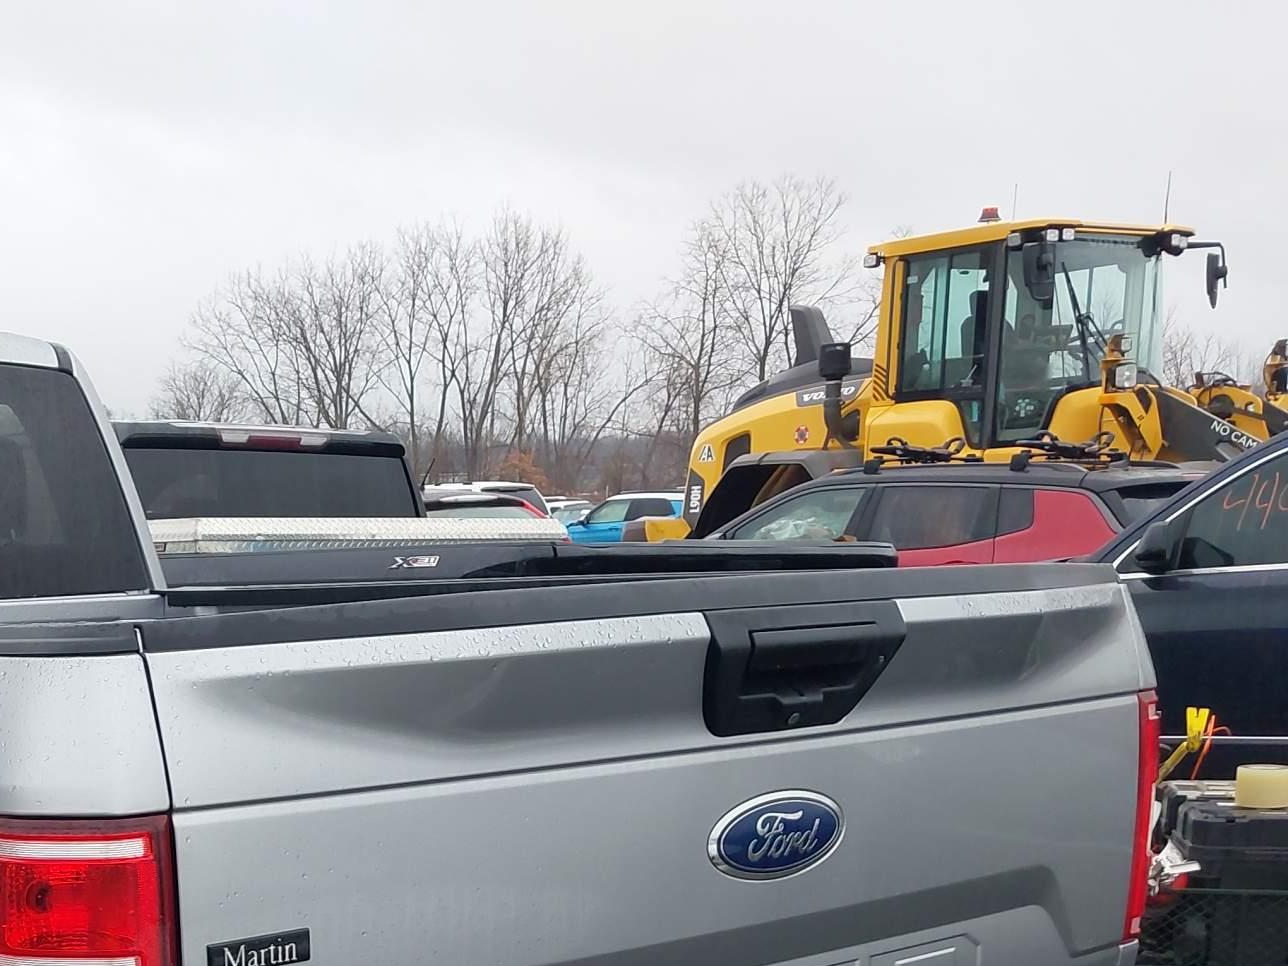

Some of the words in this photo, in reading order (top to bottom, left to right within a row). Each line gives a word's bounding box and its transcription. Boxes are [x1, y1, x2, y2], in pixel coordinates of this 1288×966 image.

[1210, 420, 1231, 436] NO
[689, 485, 703, 513] L90H
[747, 810, 822, 862] Ford
